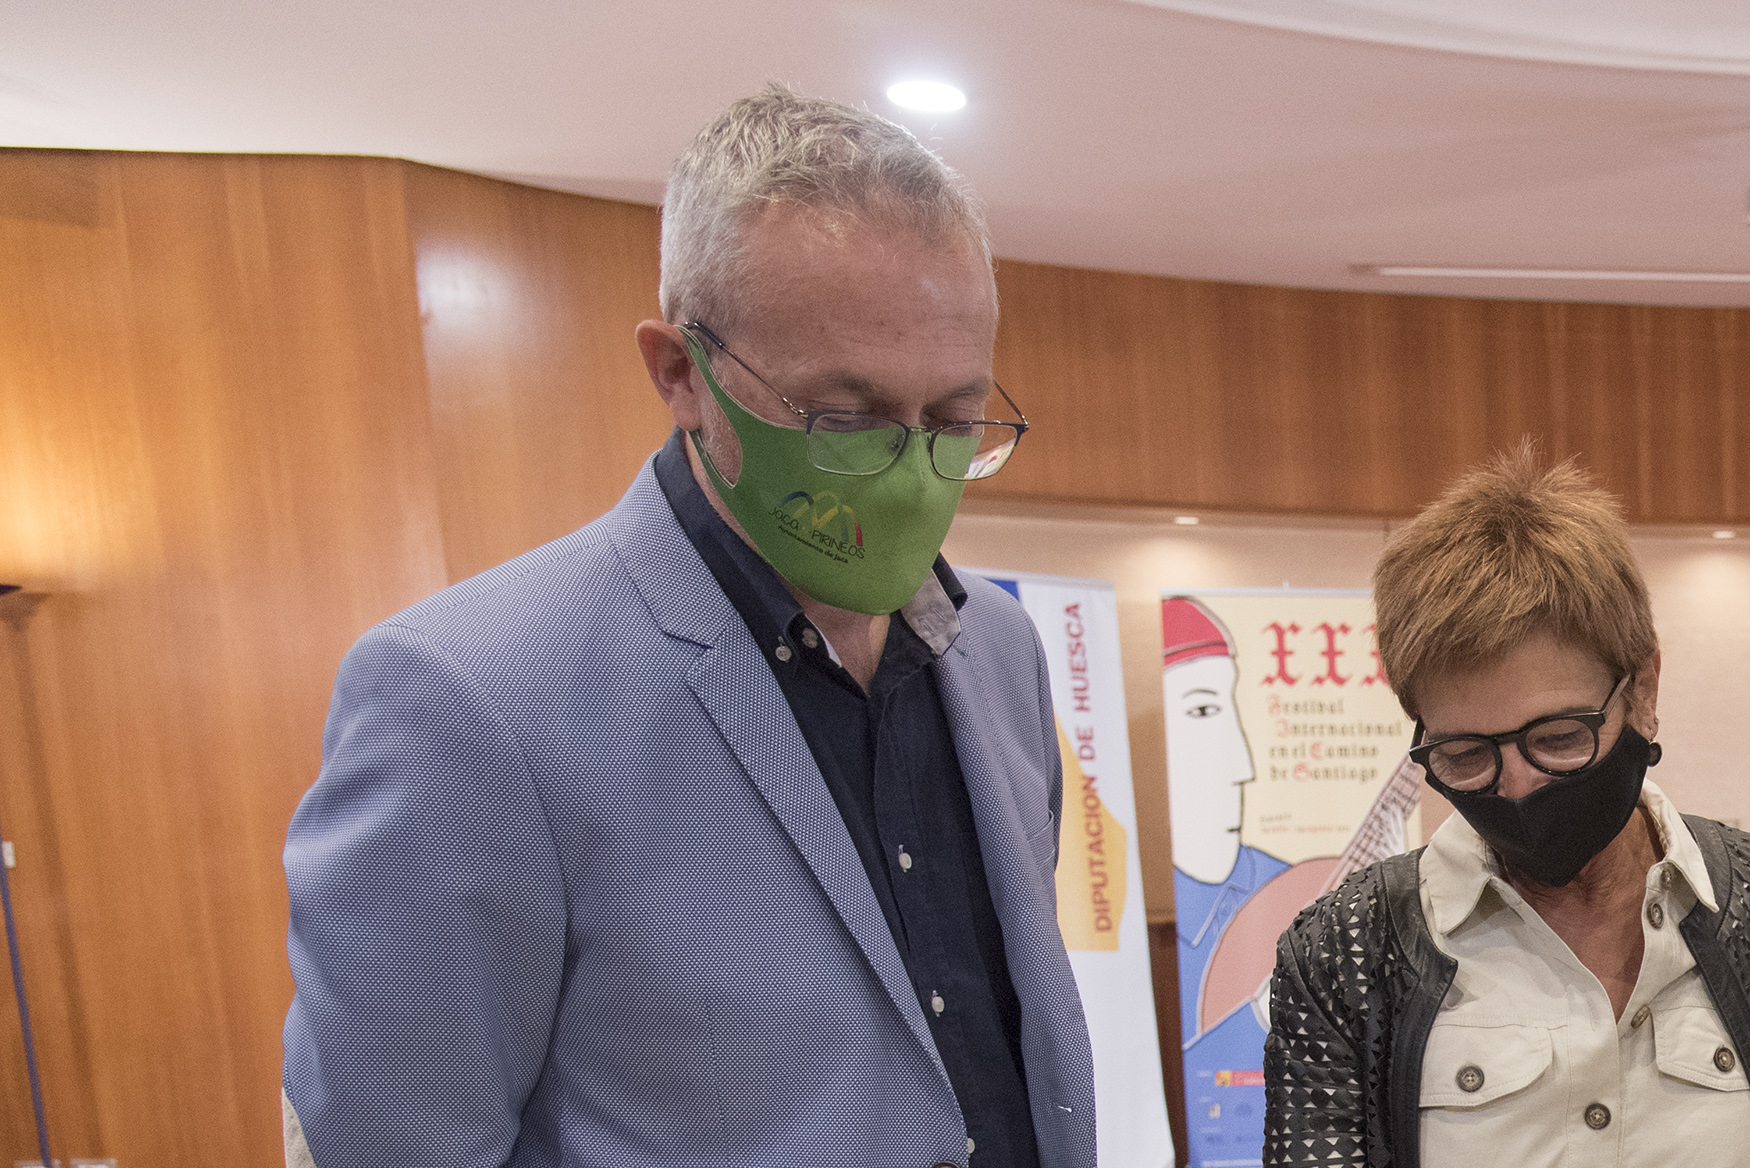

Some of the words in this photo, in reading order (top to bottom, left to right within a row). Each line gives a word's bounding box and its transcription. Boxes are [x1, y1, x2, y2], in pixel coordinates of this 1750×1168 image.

[812, 530, 865, 559] PIRINEOS
[1065, 603, 1091, 712] HUESCA
[1075, 726, 1096, 761] DE
